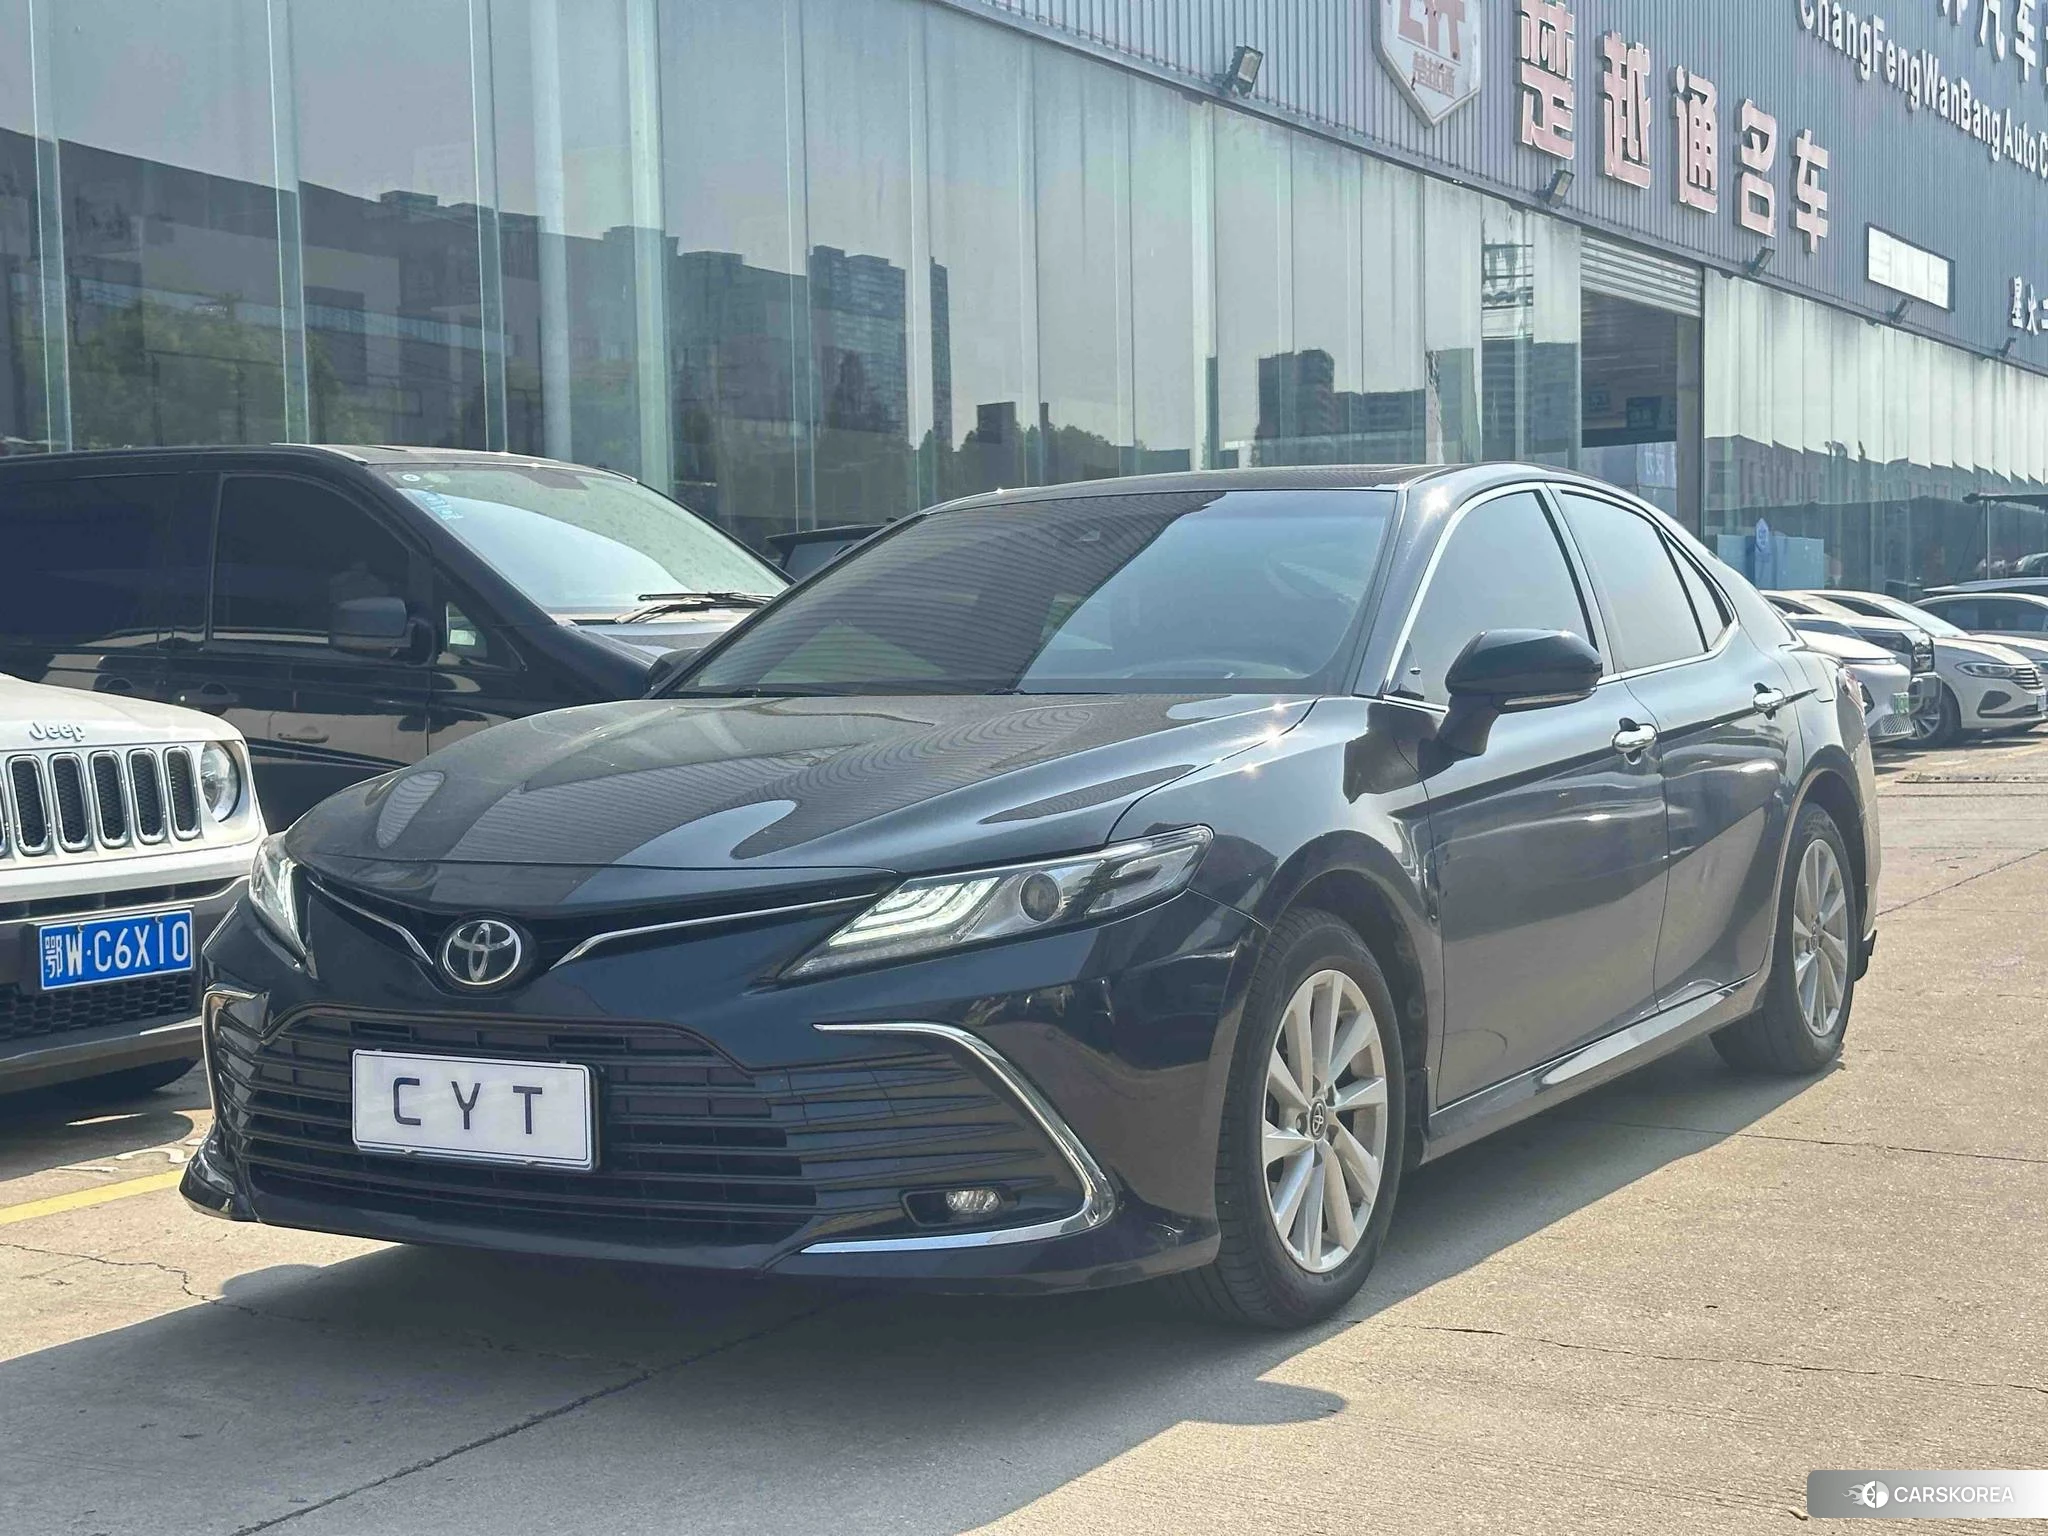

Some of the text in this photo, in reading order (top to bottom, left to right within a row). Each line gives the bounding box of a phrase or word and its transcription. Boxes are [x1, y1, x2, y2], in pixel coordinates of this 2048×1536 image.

[1521, 0, 1828, 254] 楚越通名车
[1800, 0, 2000, 162] ChangFengWanBang
[2003, 108, 2036, 172] Auto
[29, 721, 86, 742] Jeep
